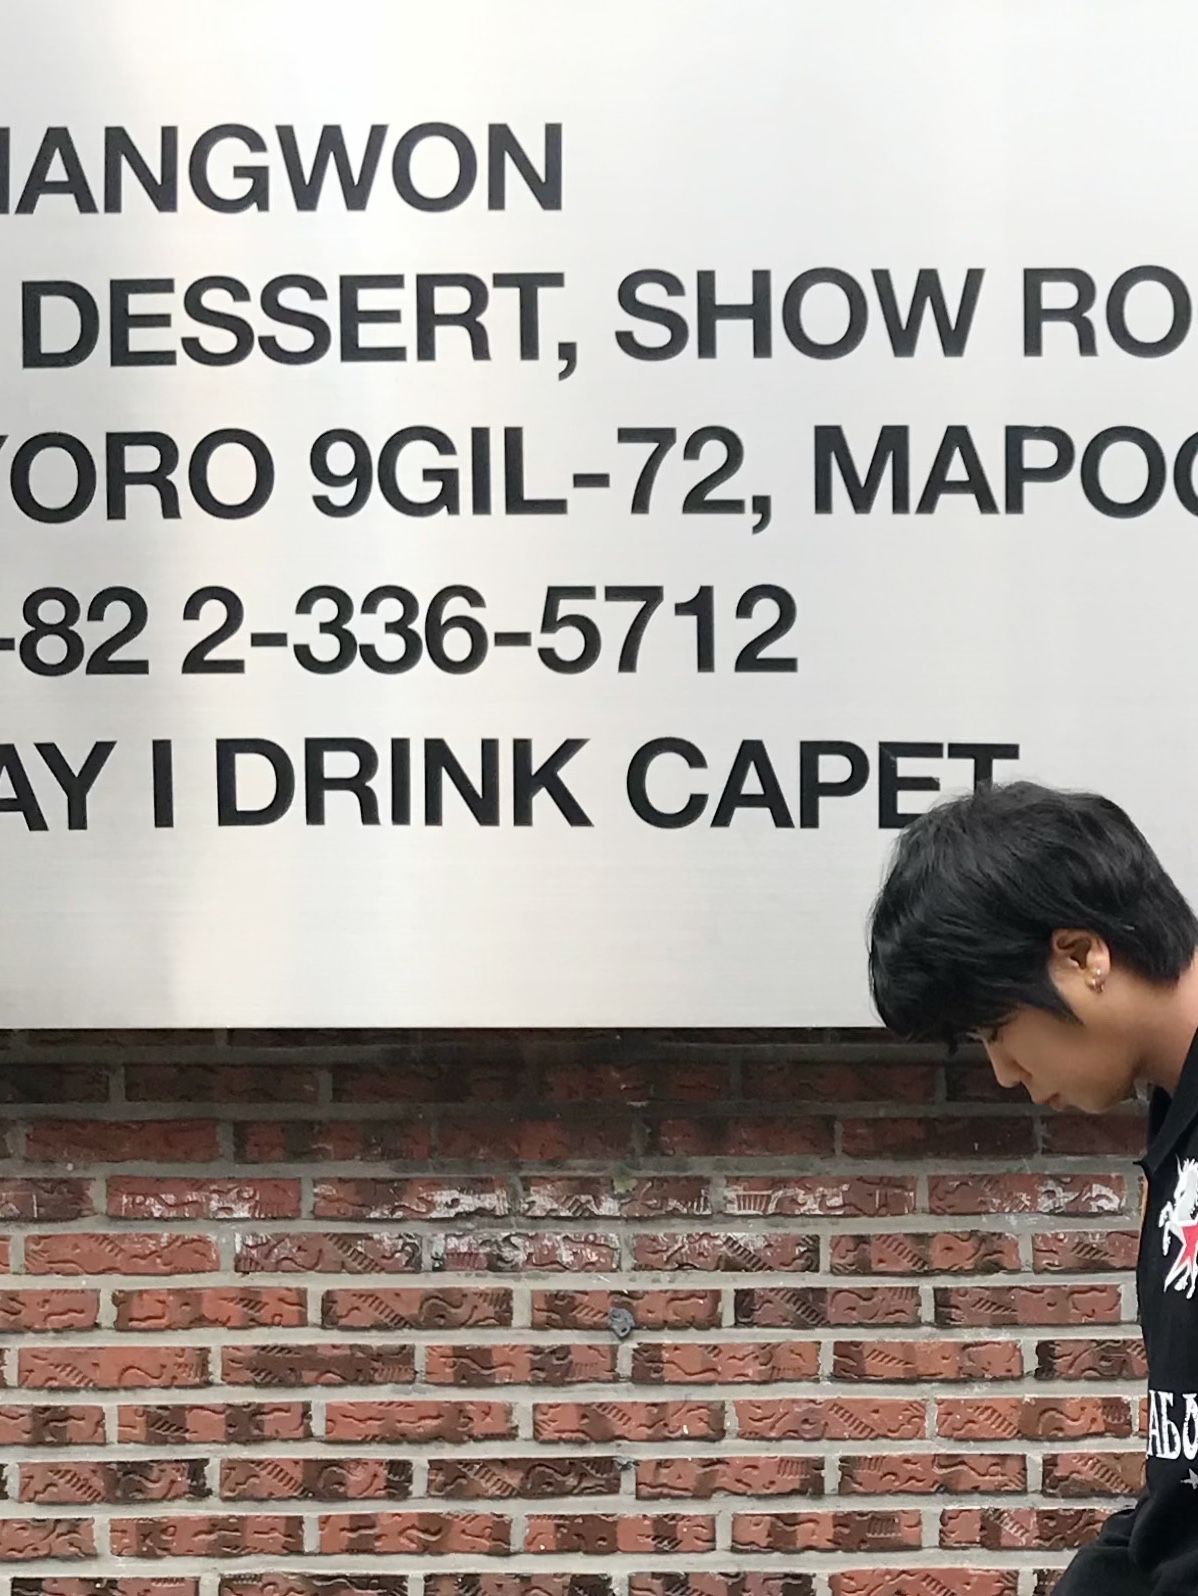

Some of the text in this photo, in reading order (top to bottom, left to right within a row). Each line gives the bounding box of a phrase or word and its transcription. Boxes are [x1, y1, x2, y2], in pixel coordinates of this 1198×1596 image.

[0, 122, 562, 215] ANGWON
[21, 268, 577, 380] DESSERT,
[615, 267, 984, 361] SHOW
[0, 428, 275, 524] ORO
[309, 426, 771, 534] 9GIL-72,
[181, 584, 798, 674] 2-336-5712
[152, 739, 174, 829] I
[215, 737, 593, 829] DRINK
[626, 736, 1020, 832] CAPET
